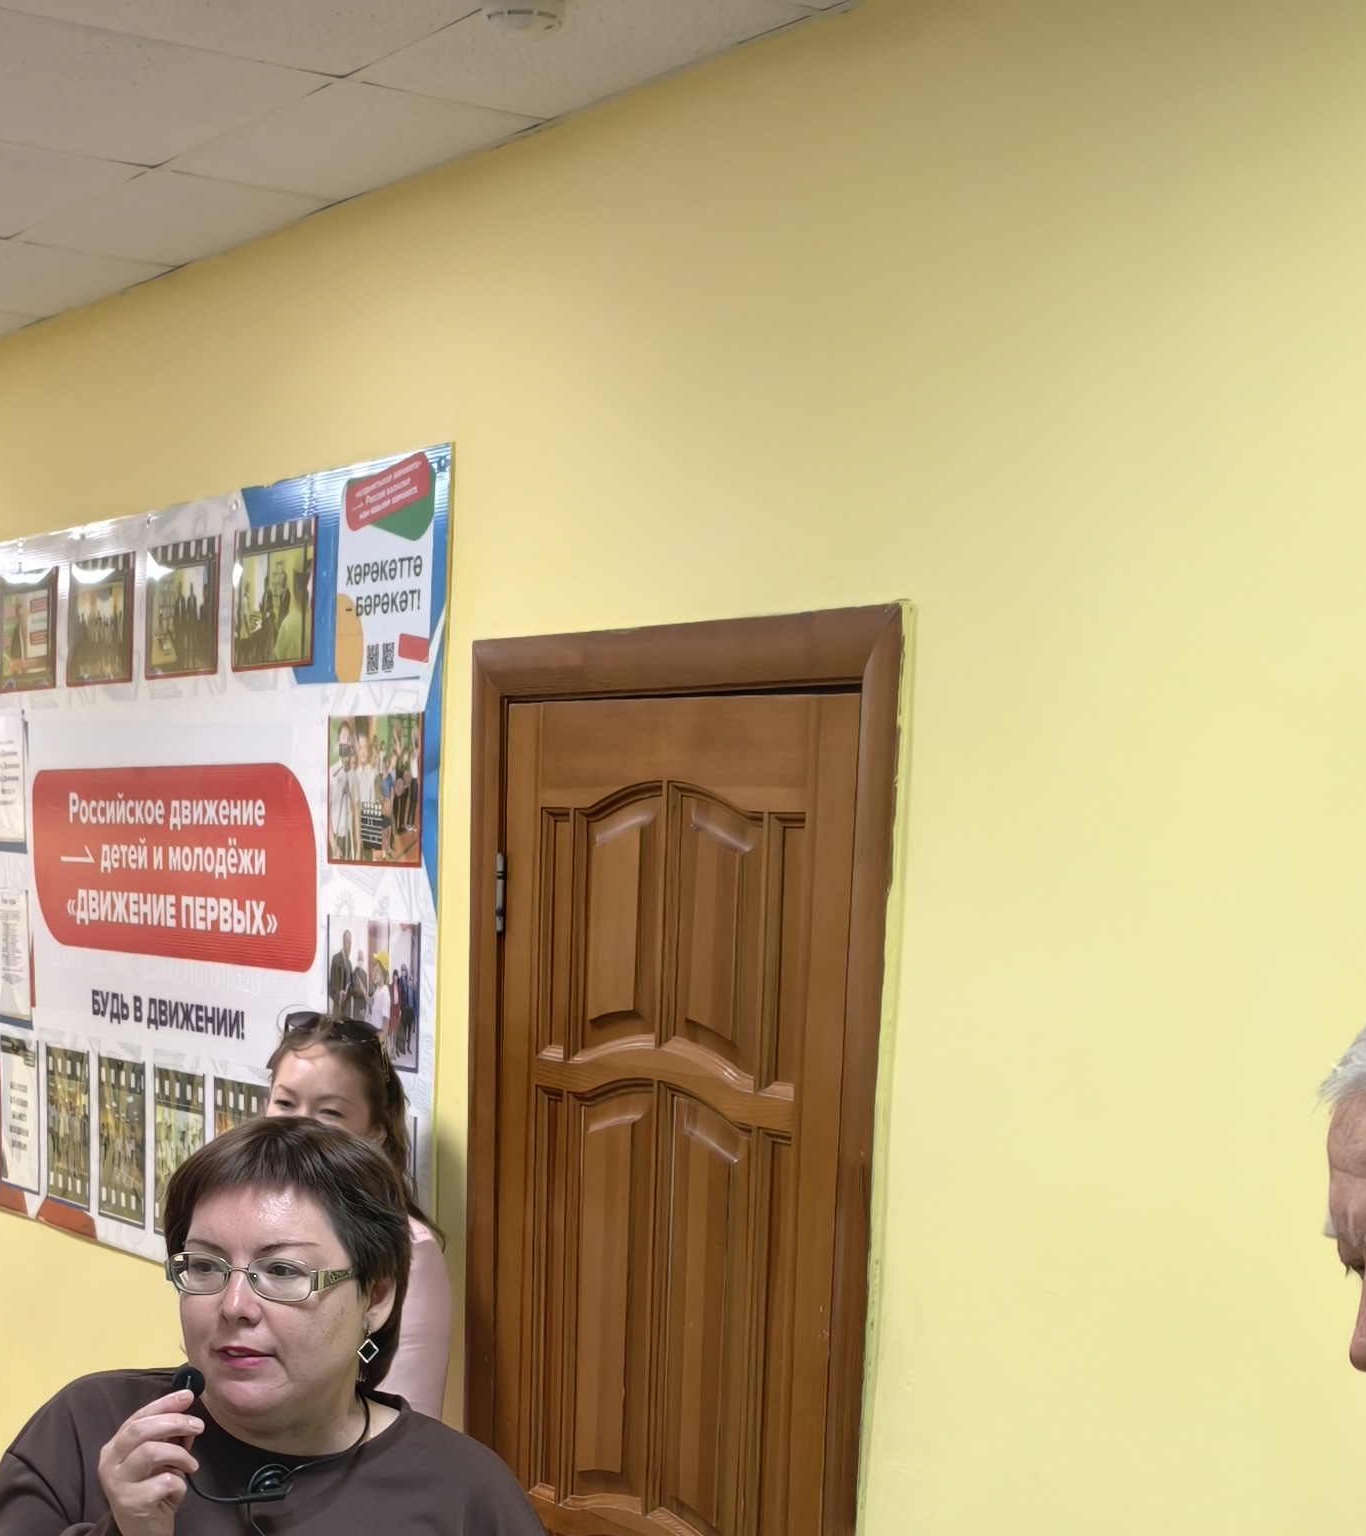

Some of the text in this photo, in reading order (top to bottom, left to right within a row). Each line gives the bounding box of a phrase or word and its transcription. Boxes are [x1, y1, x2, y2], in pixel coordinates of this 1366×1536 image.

[346, 555, 423, 586] ХӘРӘКӘТТӘ
[355, 588, 421, 618] БӘРӘКӘТ!
[68, 791, 266, 831] Российское движение
[100, 836, 266, 880] детей и молодёжи
[66, 888, 279, 936] «ДВИЖЕНИЕ ПЕРВЫХ»
[91, 989, 245, 1041] БУДЬ В ДВИЖЕНИИ!
